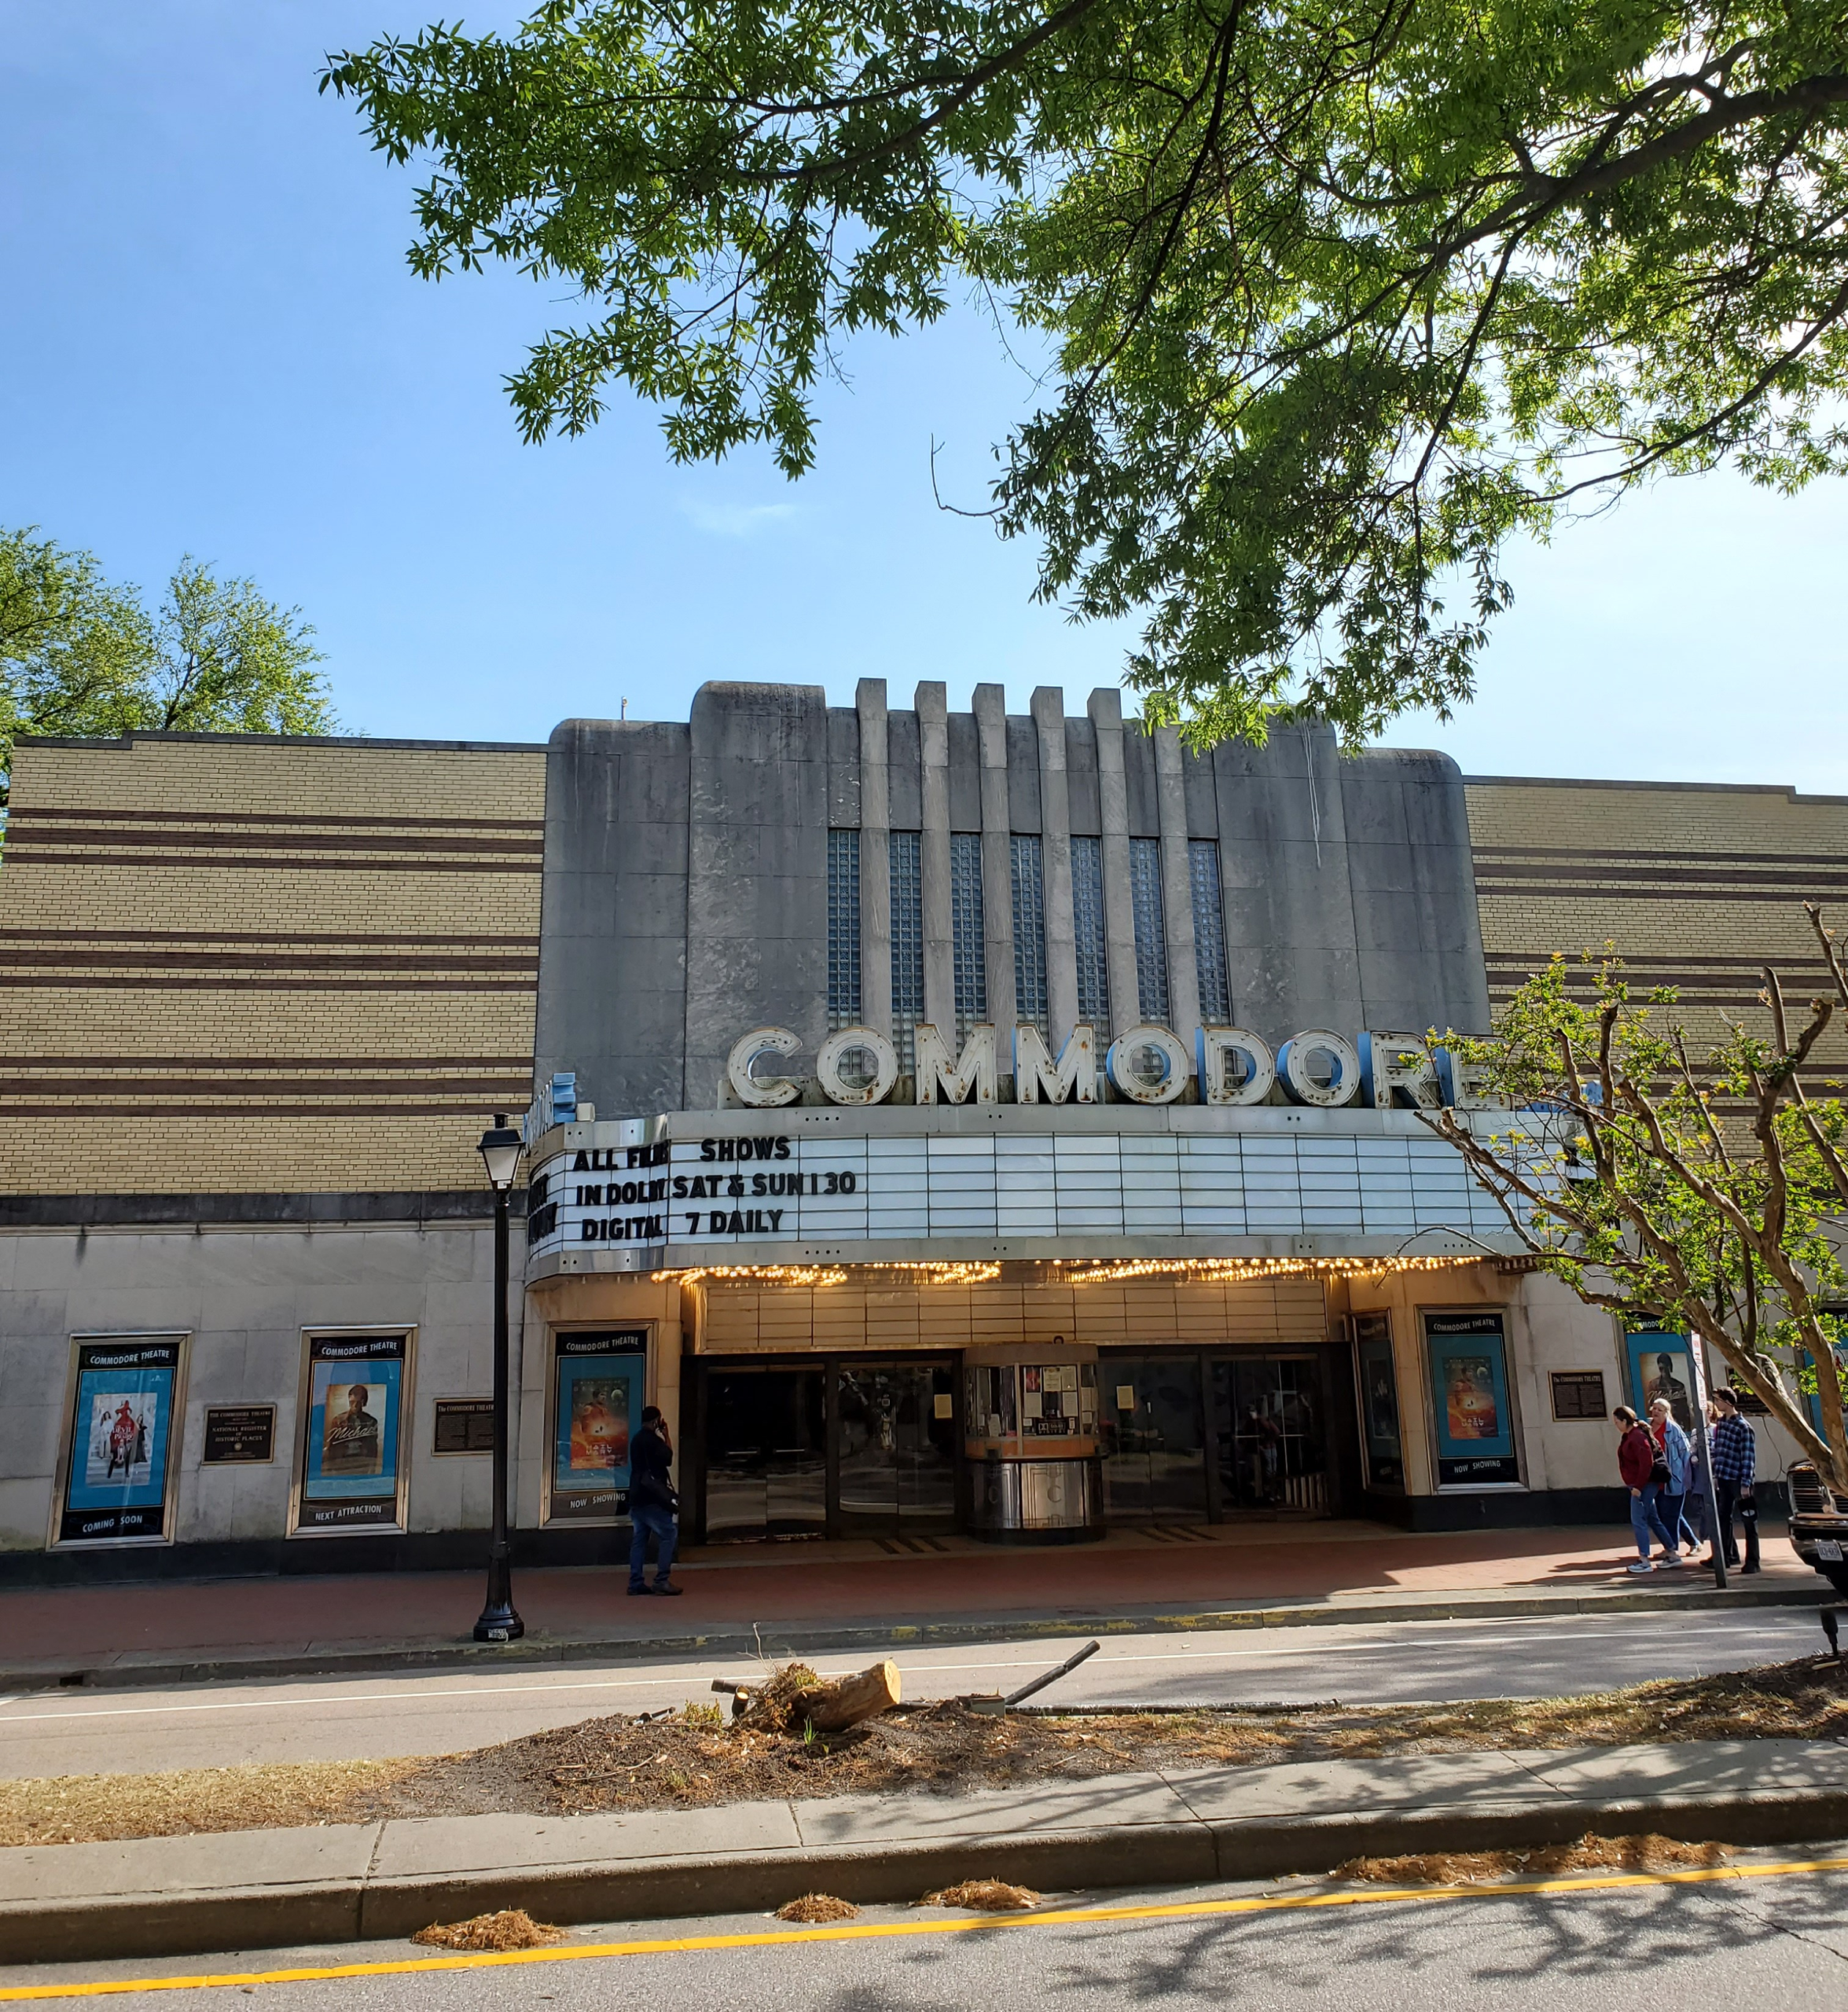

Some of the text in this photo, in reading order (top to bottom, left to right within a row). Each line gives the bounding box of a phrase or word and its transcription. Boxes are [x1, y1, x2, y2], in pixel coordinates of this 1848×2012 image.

[729, 1023, 1513, 1111] COMMODORE
[700, 1136, 791, 1162] SHOWS
[573, 1148, 619, 1171] ALL
[576, 1185, 601, 1206] IN
[606, 1177, 665, 1205] DOLBY
[672, 1175, 723, 1199] SAT
[727, 1174, 744, 1197] &
[751, 1173, 804, 1196] SUN
[582, 1214, 663, 1241] DIGITAL
[685, 1210, 784, 1235] 7 DAILY
[1434, 1319, 1495, 1331] COMMODORE THEATRE
[321, 1341, 397, 1356] COMMODORE THEATRE
[566, 1336, 638, 1351] COMMODORE THEATRE
[90, 1349, 170, 1365] COMMODORE THEATRE
[326, 1424, 379, 1442] Michael
[1454, 1460, 1501, 1473] NOW SHOWING
[570, 1493, 626, 1509] NOW SHOWING
[315, 1505, 382, 1521] NEXT ATTRACTION
[83, 1515, 142, 1533] COMING SOON
